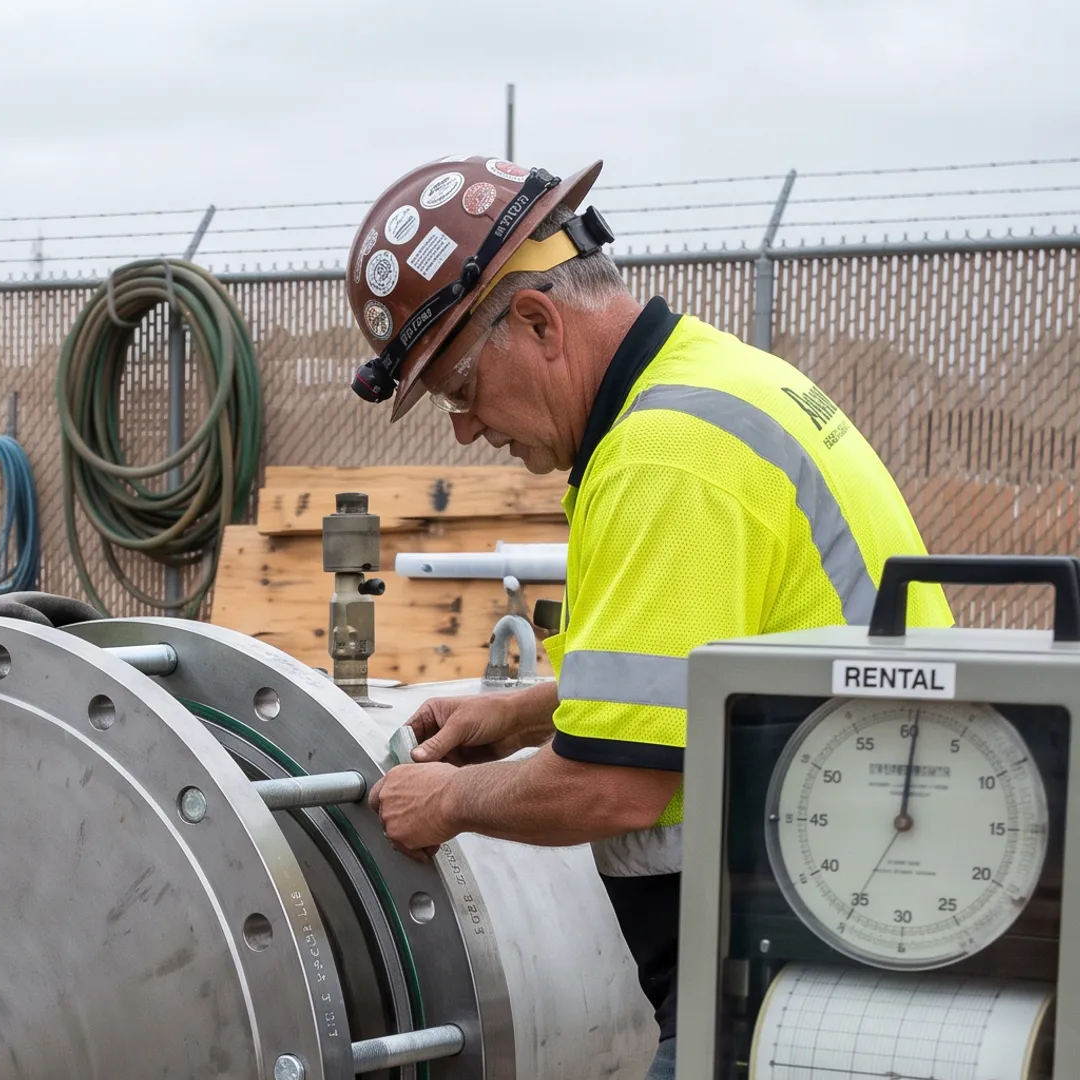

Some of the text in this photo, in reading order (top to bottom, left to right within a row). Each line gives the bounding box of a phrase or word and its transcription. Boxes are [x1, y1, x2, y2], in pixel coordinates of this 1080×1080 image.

[845, 666, 945, 691] RENTAL
[900, 724, 919, 739] 60
[856, 737, 875, 751] 55
[950, 739, 960, 753] 5
[823, 770, 842, 784] 50
[978, 776, 996, 790] 10
[809, 813, 828, 827] 45
[989, 822, 1006, 836] 15
[820, 859, 839, 873] 40
[972, 866, 991, 881] 20
[851, 892, 869, 906] 35
[938, 897, 957, 912] 25
[893, 909, 913, 924] 30
